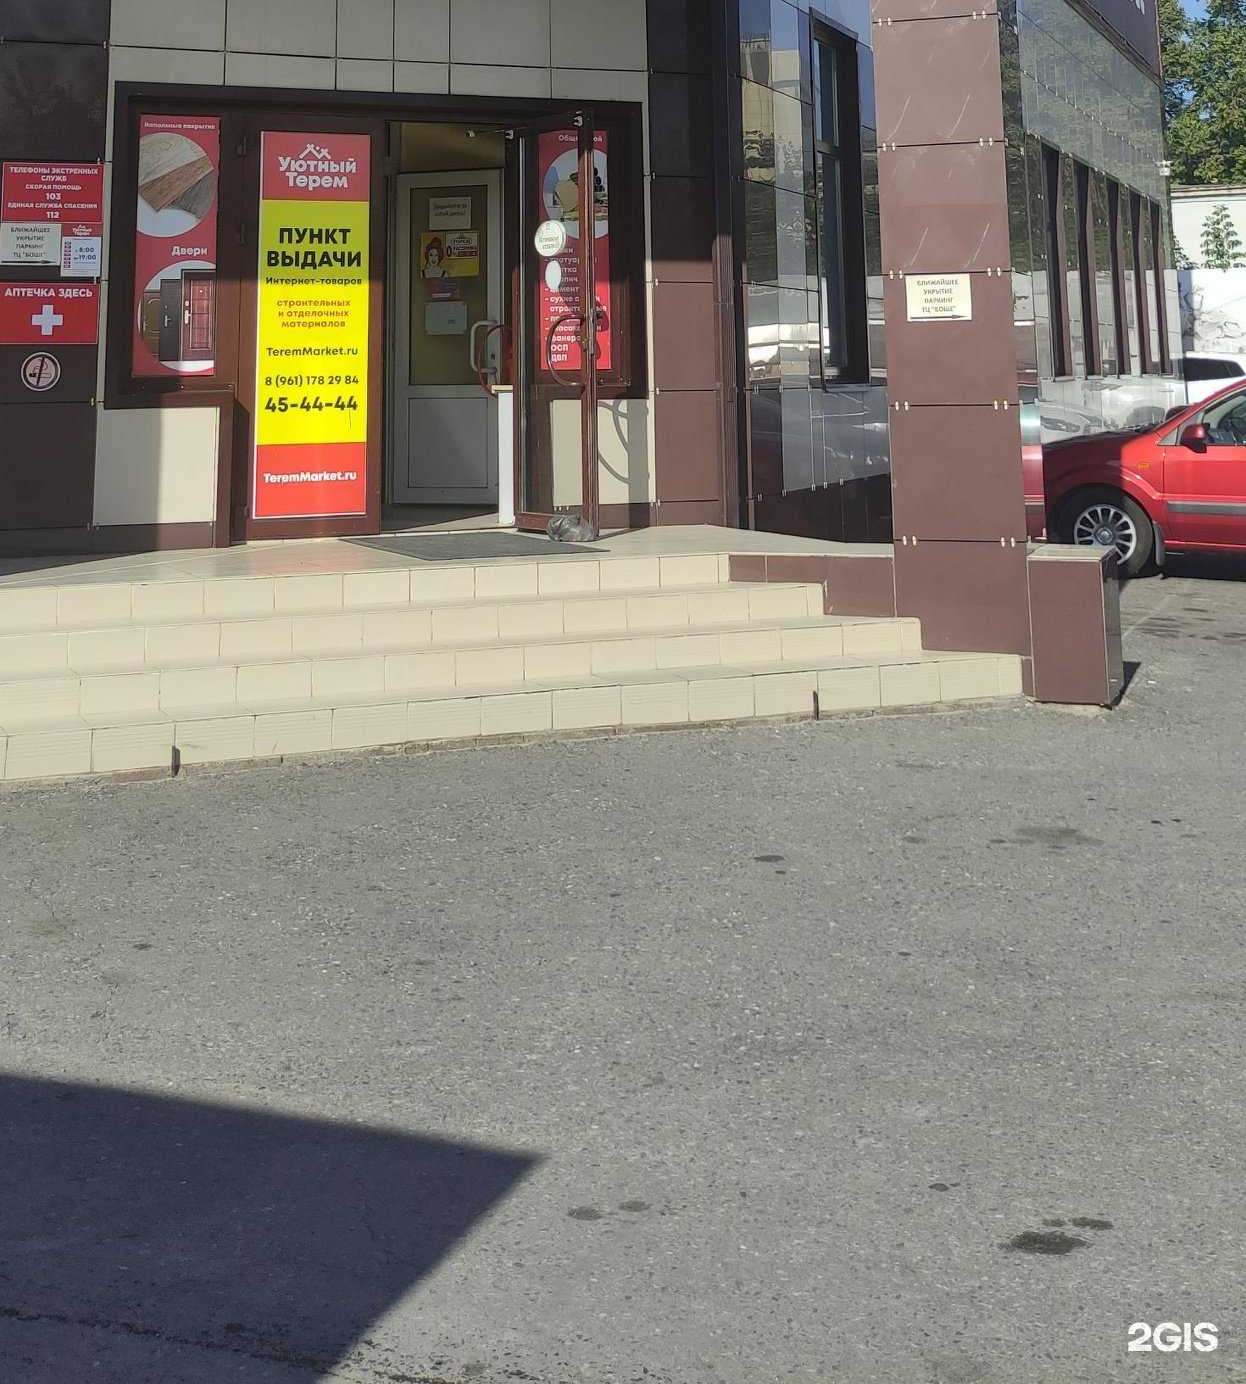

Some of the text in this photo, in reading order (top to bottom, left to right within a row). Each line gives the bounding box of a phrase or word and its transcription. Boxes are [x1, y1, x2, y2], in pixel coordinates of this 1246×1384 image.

[9, 166, 50, 174] ТЕЛЕФОНЫ
[278, 156, 358, 173] Уютный
[285, 171, 349, 191] Терем
[45, 192, 62, 201] 103
[46, 211, 60, 219] 112
[279, 227, 351, 244] ПУНКТ
[171, 245, 208, 257] Двери
[267, 250, 362, 270] ВЫДАЧИ
[265, 276, 362, 287] Интернет-товаров
[4, 287, 93, 298] АПТЕЧКА ЗДЕСЬ
[286, 309, 350, 318] отделочных
[281, 320, 346, 328] материалов
[266, 347, 358, 357] TeremMarket.ru
[265, 374, 359, 387] 8 (961) 178 29 84
[265, 395, 358, 413] 45-44-44
[263, 471, 357, 484] TeremMarket.ru
